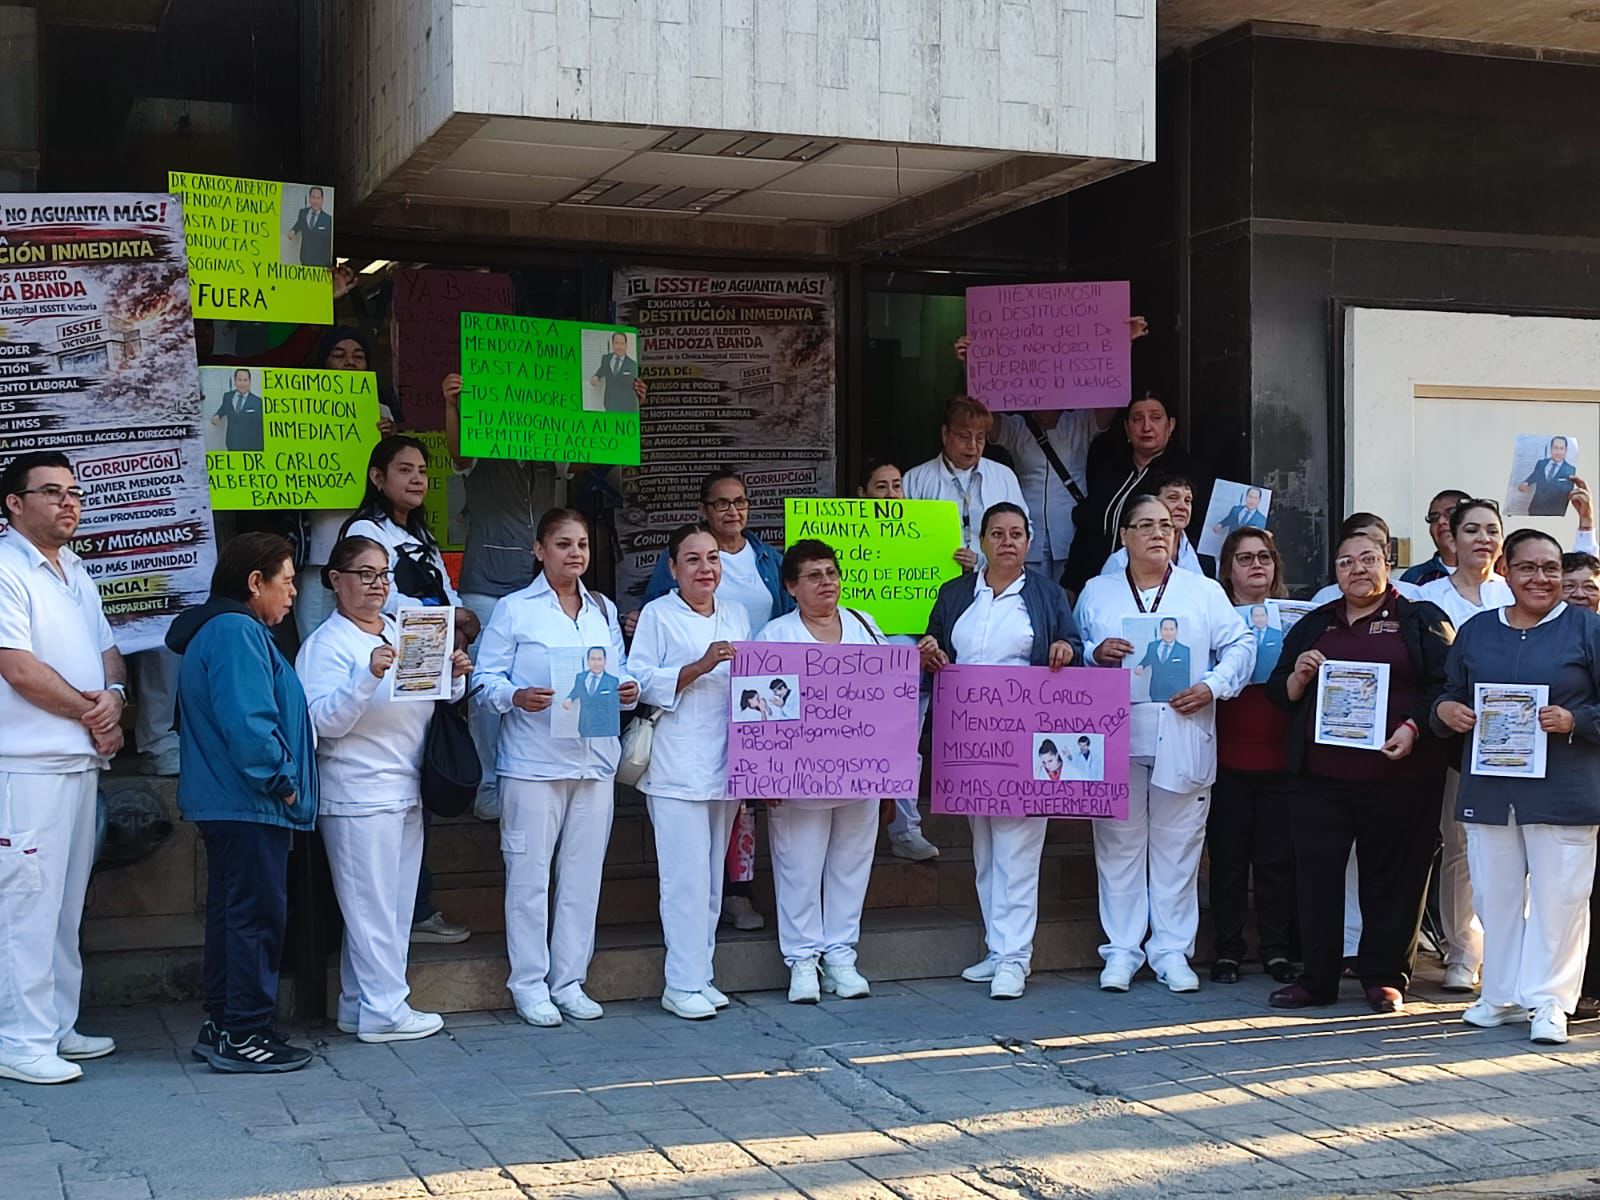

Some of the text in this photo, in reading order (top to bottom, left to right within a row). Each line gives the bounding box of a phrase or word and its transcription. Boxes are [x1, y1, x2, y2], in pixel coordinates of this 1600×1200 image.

[172, 173, 187, 189] DR
[191, 175, 232, 193] CARLOS
[6, 208, 27, 222] NO
[31, 206, 112, 222] AGUANTA
[114, 201, 167, 223] MÁS!
[236, 198, 277, 216] BANDA
[184, 214, 270, 238] ASTA DE TUS
[52, 240, 154, 261] INMEDIATA
[185, 233, 260, 256] ONDUCTAS
[14, 270, 67, 283] ALBERTO
[252, 261, 262, 278] Y
[21, 281, 87, 300] BANDA
[627, 277, 825, 295] ¡EL ISSSTE NO AGUANTA MÁS!
[2, 302, 97, 316] Hospital ISSSTE Victoria
[648, 300, 711, 308] EXIGIMOS LA
[639, 306, 813, 323] DESTITUCIÓN INMEDIATA
[62, 319, 102, 337] ISSSTE
[464, 314, 482, 332] DR
[486, 314, 540, 336] CARLOS
[546, 322, 559, 337] A
[659, 328, 674, 336] DR.
[676, 328, 710, 336] CARLOS
[712, 327, 750, 336] ALBERTO
[1053, 324, 1080, 338] del
[62, 334, 101, 349] VICTORIA
[465, 335, 533, 353] MENDOZA
[537, 342, 577, 362] BANDA
[644, 336, 763, 350] MENDOZA BANDA
[1102, 340, 1112, 352] B
[470, 359, 529, 376] BASTA
[674, 366, 692, 376] DE:
[743, 366, 772, 378] ISSSTE
[1070, 358, 1115, 371] ISSSTE
[30, 380, 79, 391] LABORAL
[264, 371, 371, 395] EXIGIMOS LA
[650, 382, 678, 390] ABUSO
[693, 382, 720, 390] PODER
[505, 384, 582, 411] AVIADORES
[682, 395, 719, 404] GESTIÓN
[264, 396, 356, 418] DESTITUCION
[650, 409, 715, 419] HOSTIGAMIENTO
[12, 419, 40, 429] IMSS
[477, 410, 636, 436] TU ARROGANCIA NO
[657, 423, 706, 432] AVIADORES
[20, 438, 35, 447] NO
[38, 435, 84, 446] PERMITIR
[94, 432, 127, 442] ACCESO
[128, 431, 136, 440] A
[138, 427, 186, 439] DIRECCIÓN
[270, 421, 361, 443] INMEDIATA
[467, 428, 618, 450] PERMITIR ACCESO
[489, 444, 501, 457] A
[654, 438, 689, 446] AMIGOS
[701, 438, 722, 446] IMSS
[82, 454, 174, 479] CORRUPCIÓN
[206, 452, 341, 472] DEL DR CARLOS
[650, 464, 687, 472] AUSENCIA
[88, 474, 184, 495] JAVIER MENDOZA
[208, 471, 356, 490] ALBERTO MENDOZA
[746, 473, 812, 484] CORRUPCIÓN
[89, 488, 171, 506] DE MATERIALES
[252, 490, 318, 507] BANDA
[750, 487, 818, 497] JAVIER MENDOZA
[93, 515, 109, 524] CON
[111, 508, 176, 522] PROVEEDORES
[650, 512, 697, 523] SEÑALADO
[816, 501, 904, 519] ISSSTE NO
[800, 520, 870, 538] AGUANTA
[108, 527, 193, 551] MITÓMANAS
[634, 534, 670, 546] CONDU
[87, 551, 197, 576] NO MÁS IMPUNIDAD!
[635, 554, 654, 568] ¡NO
[874, 566, 942, 581] DE PODER
[881, 585, 938, 600] GESTIÓ
[837, 682, 885, 700] abuso
[893, 682, 917, 699] de
[951, 707, 1129, 733] MENDOZA BANDA POR
[776, 722, 875, 743] hostigamiento
[741, 737, 793, 751] laboral
[944, 741, 1014, 760] MISOGINO
[769, 756, 783, 774] tu
[936, 779, 1129, 800] NO MAS CONDUCTAS HOSTILES
[945, 798, 1011, 814] CONTRA
